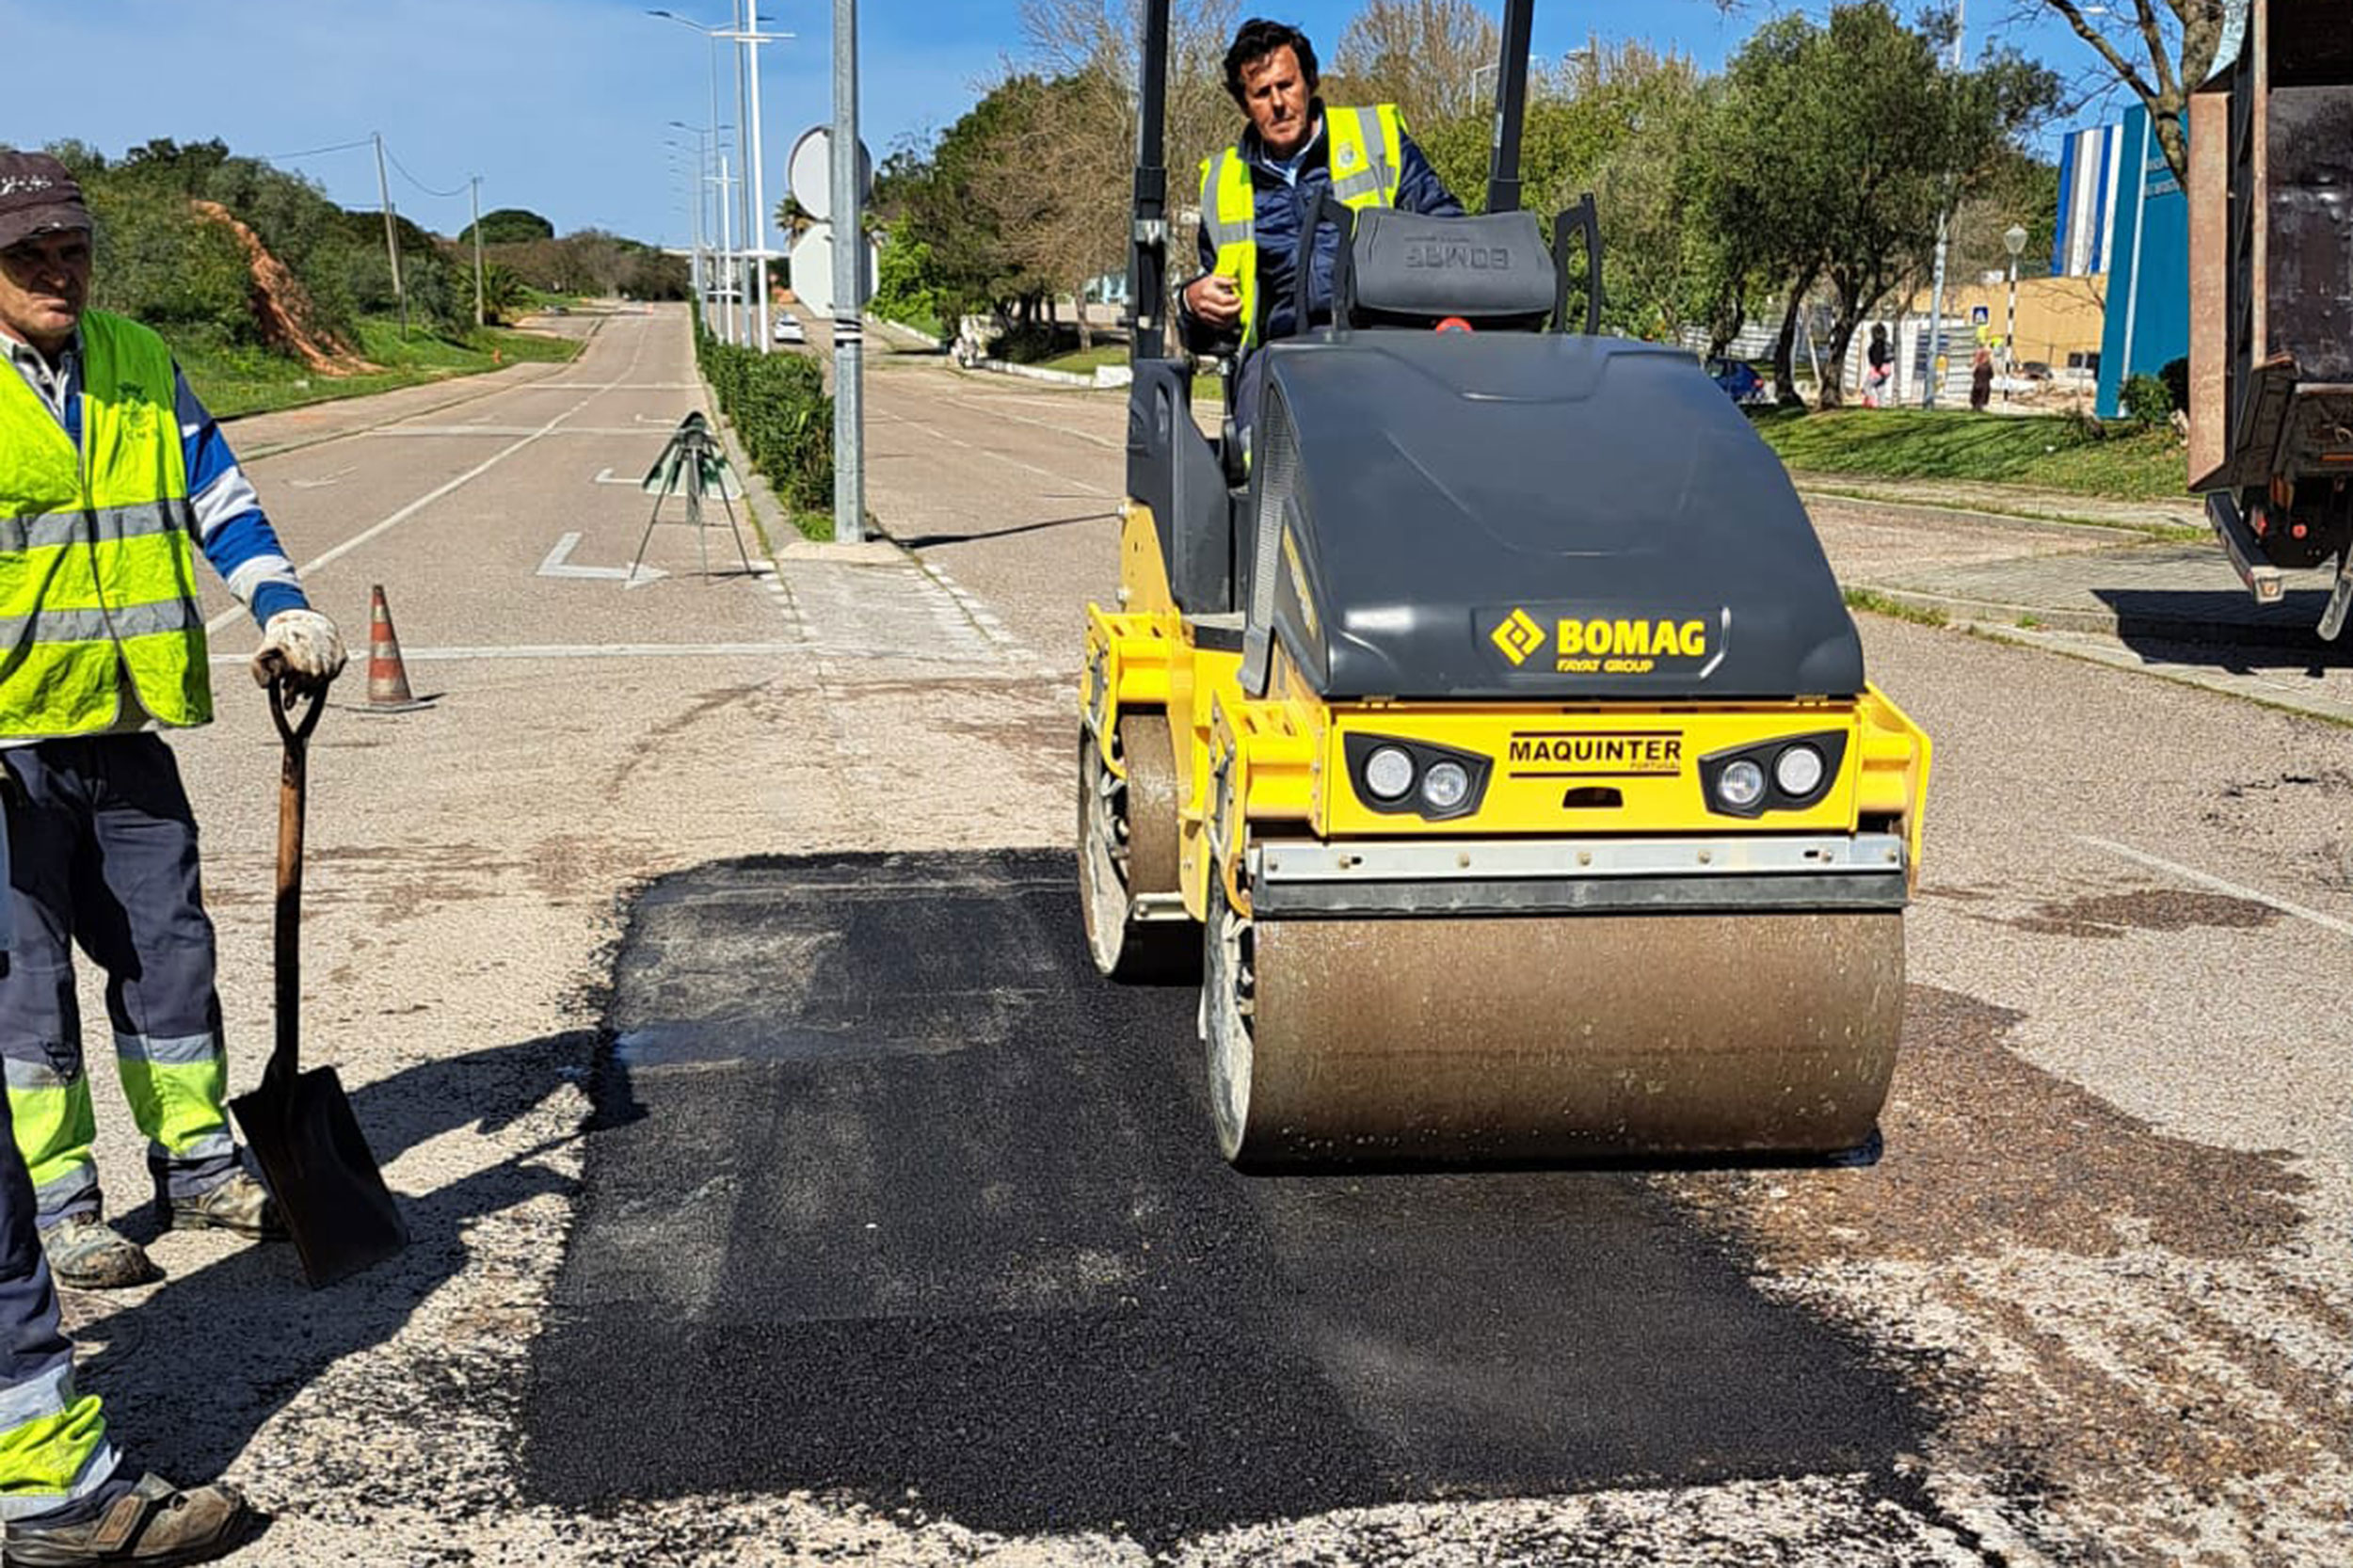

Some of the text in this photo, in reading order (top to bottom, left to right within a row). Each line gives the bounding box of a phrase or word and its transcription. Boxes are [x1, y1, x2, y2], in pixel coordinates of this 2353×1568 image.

[1557, 619, 1705, 656] BOMAG
[1557, 659, 1654, 672] FAYAT GROUP
[1509, 740, 1682, 761] MAQUINTER
